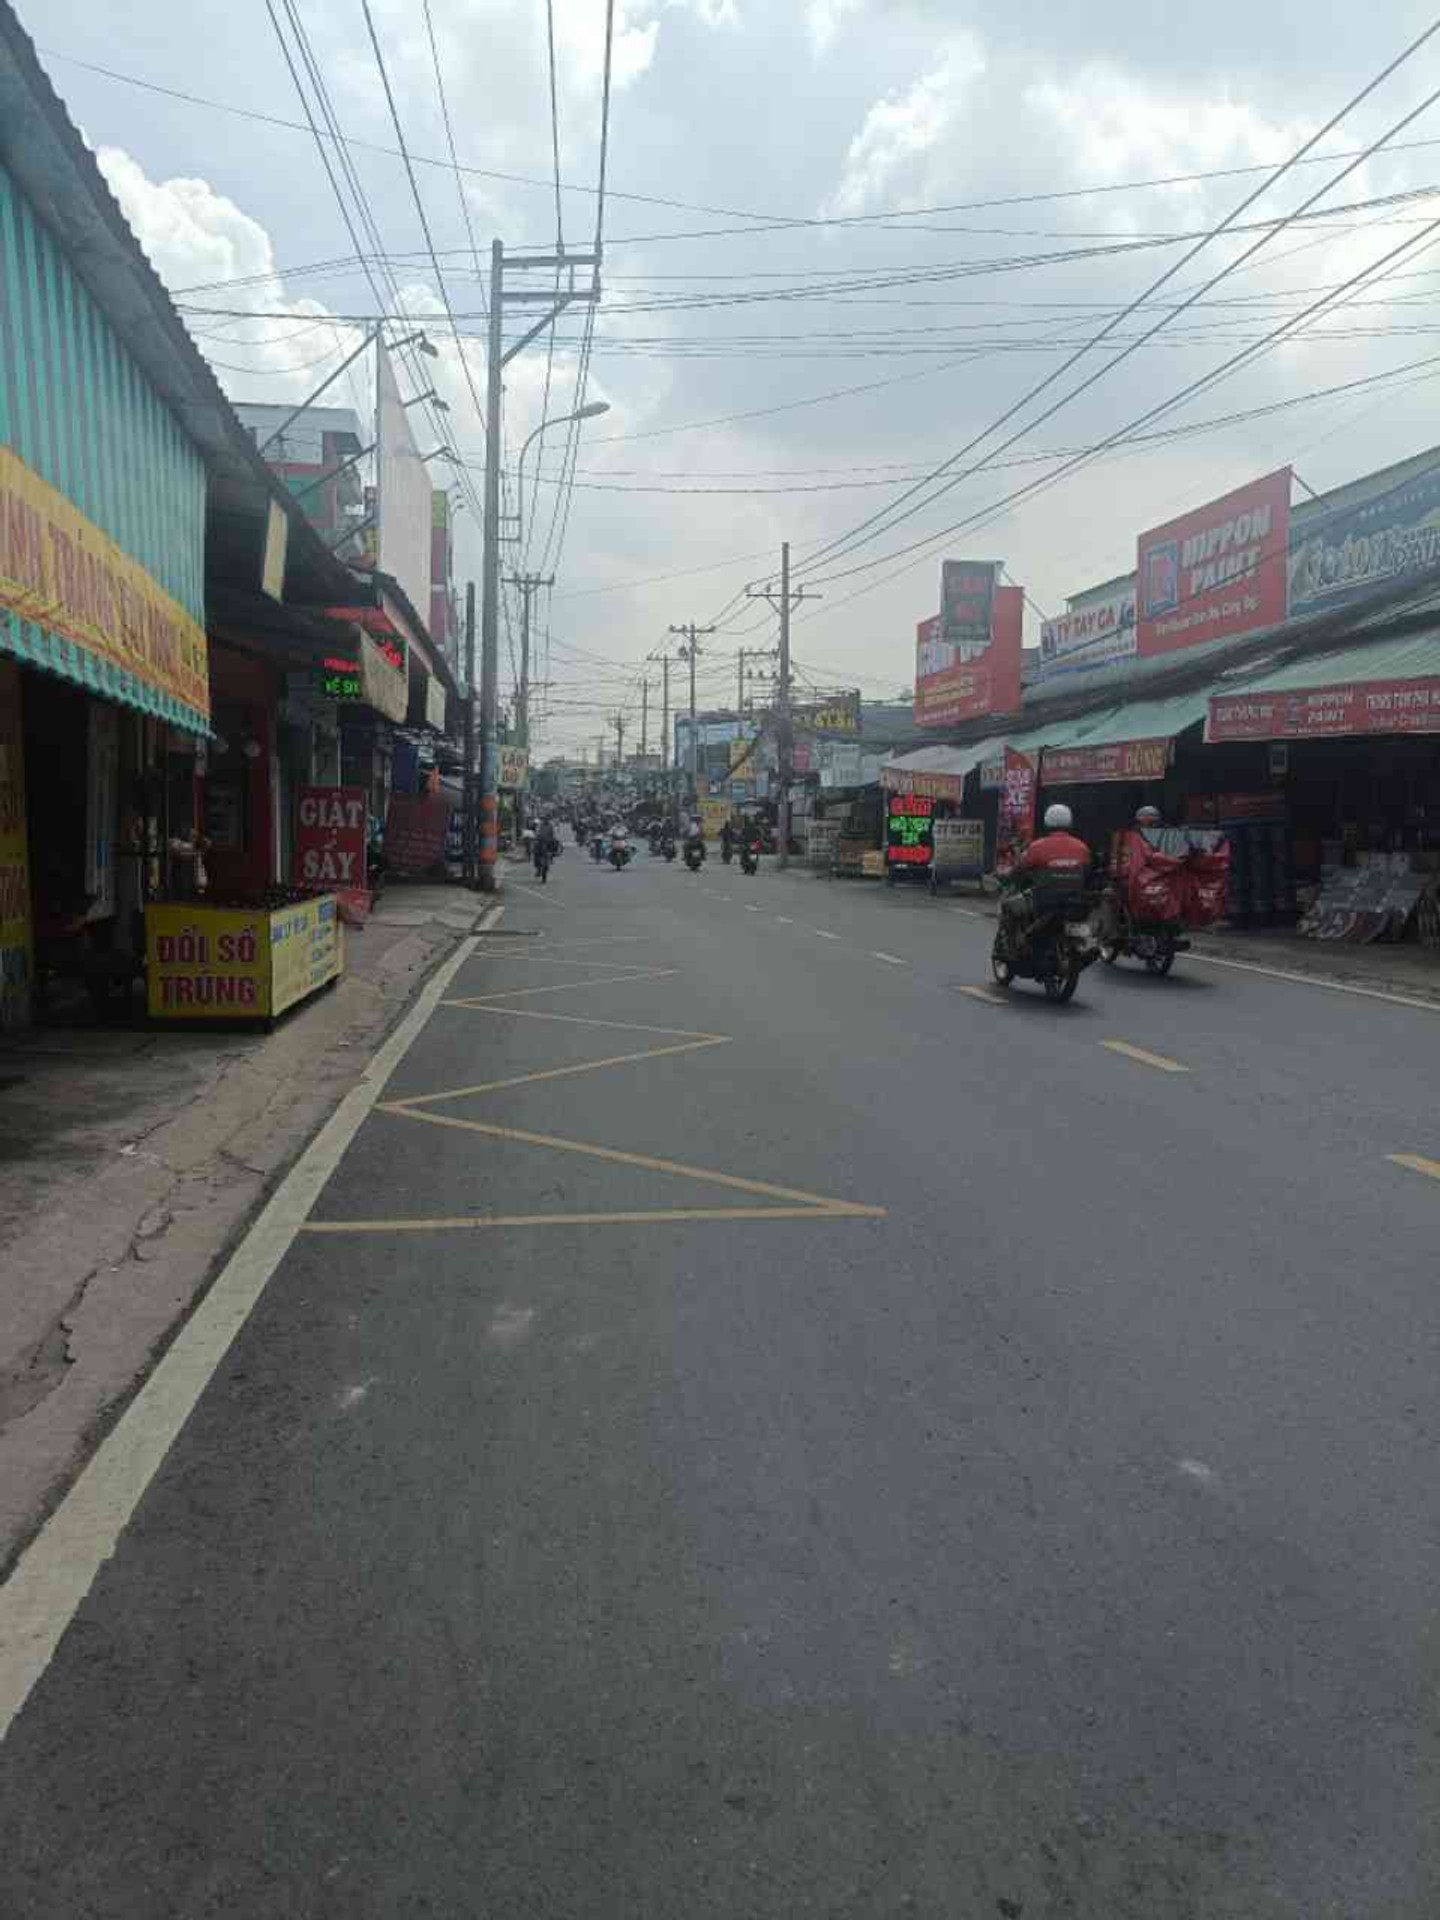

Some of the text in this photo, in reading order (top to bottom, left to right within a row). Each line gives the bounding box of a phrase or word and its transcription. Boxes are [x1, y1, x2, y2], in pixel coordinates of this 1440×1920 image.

[1181, 503, 1272, 569] NIPPON
[1190, 545, 1262, 595] PAINT
[217, 924, 257, 962] SỐ
